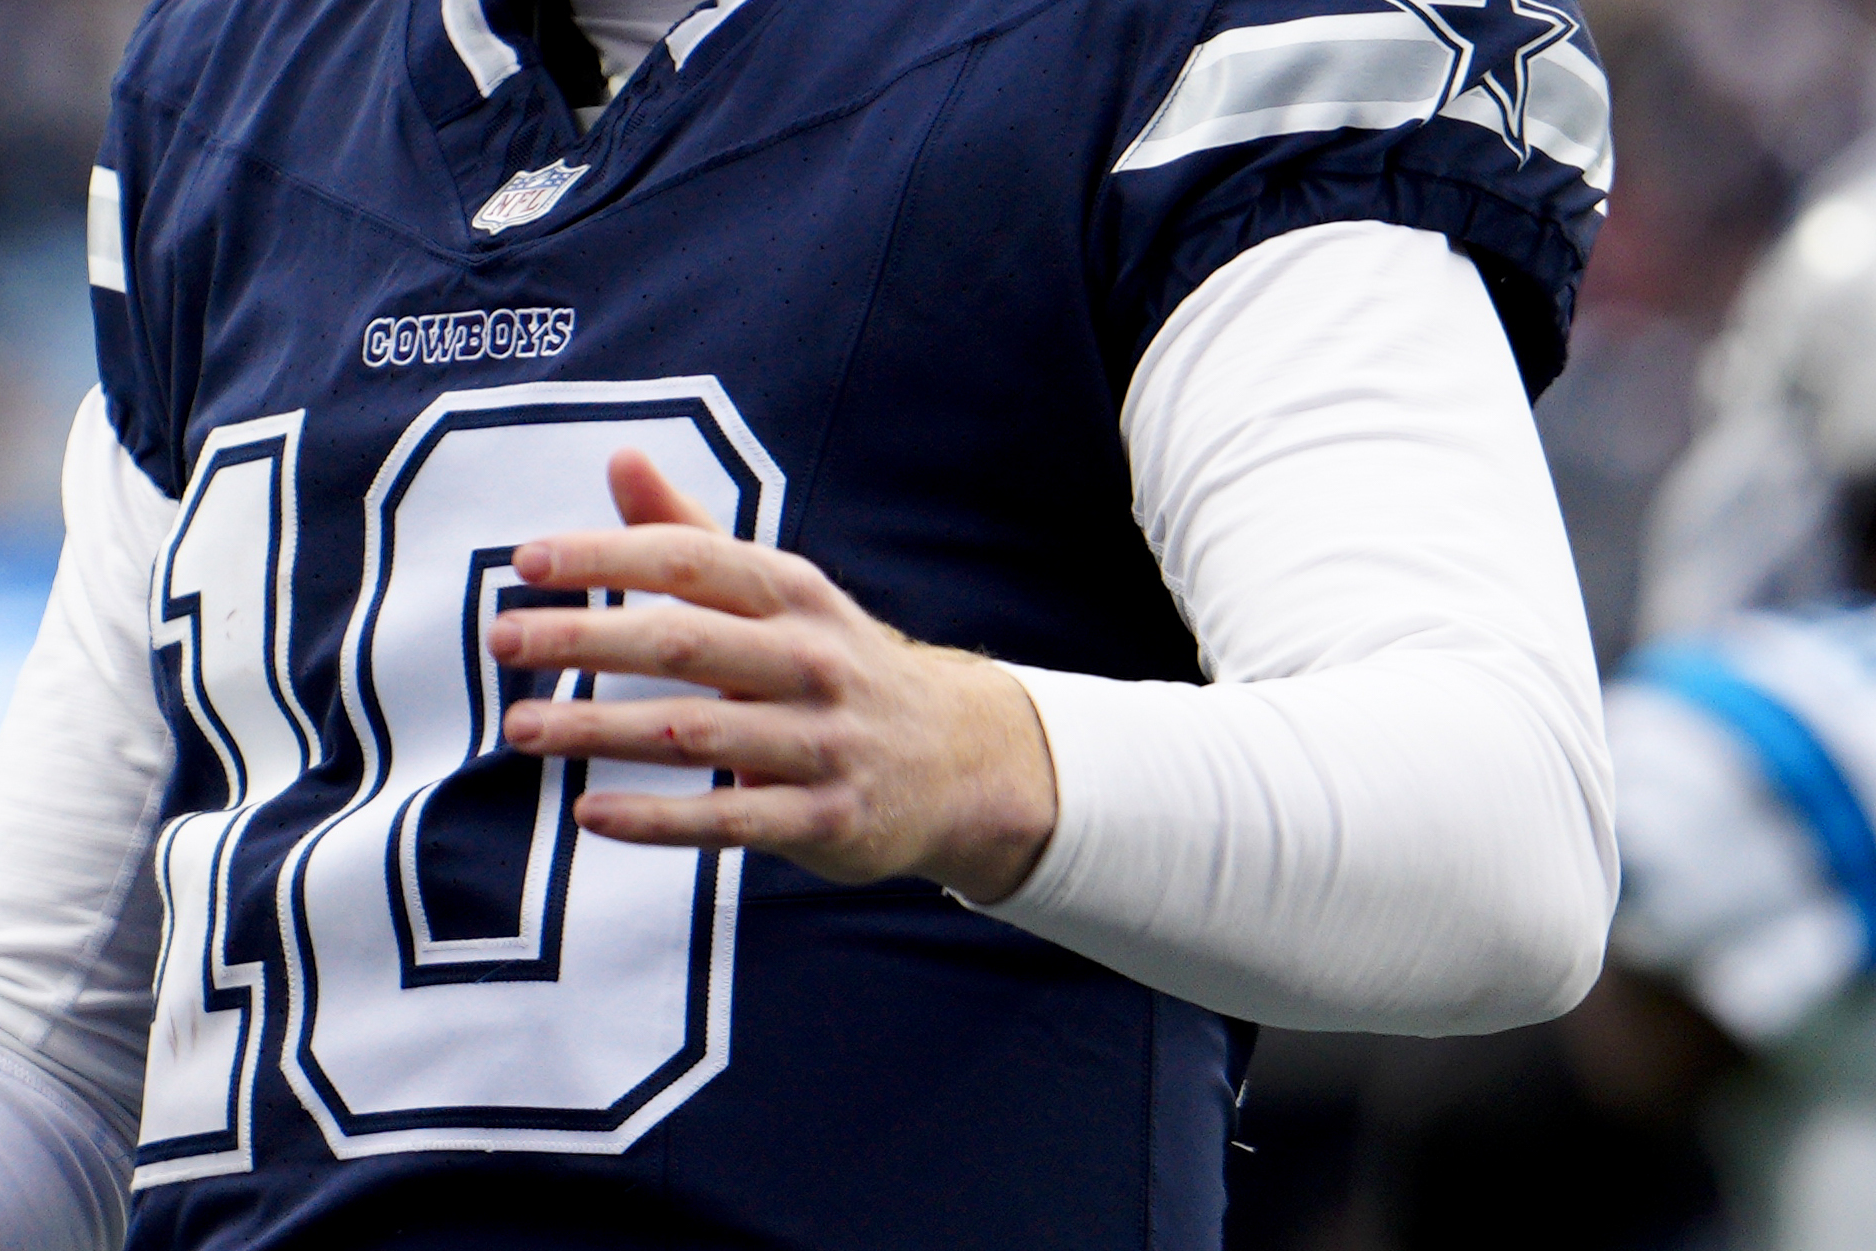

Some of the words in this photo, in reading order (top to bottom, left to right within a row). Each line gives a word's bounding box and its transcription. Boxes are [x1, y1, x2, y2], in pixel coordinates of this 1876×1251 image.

[486, 188, 548, 218] NFL
[362, 307, 575, 367] COWBOYS
[131, 375, 788, 1191] 10
